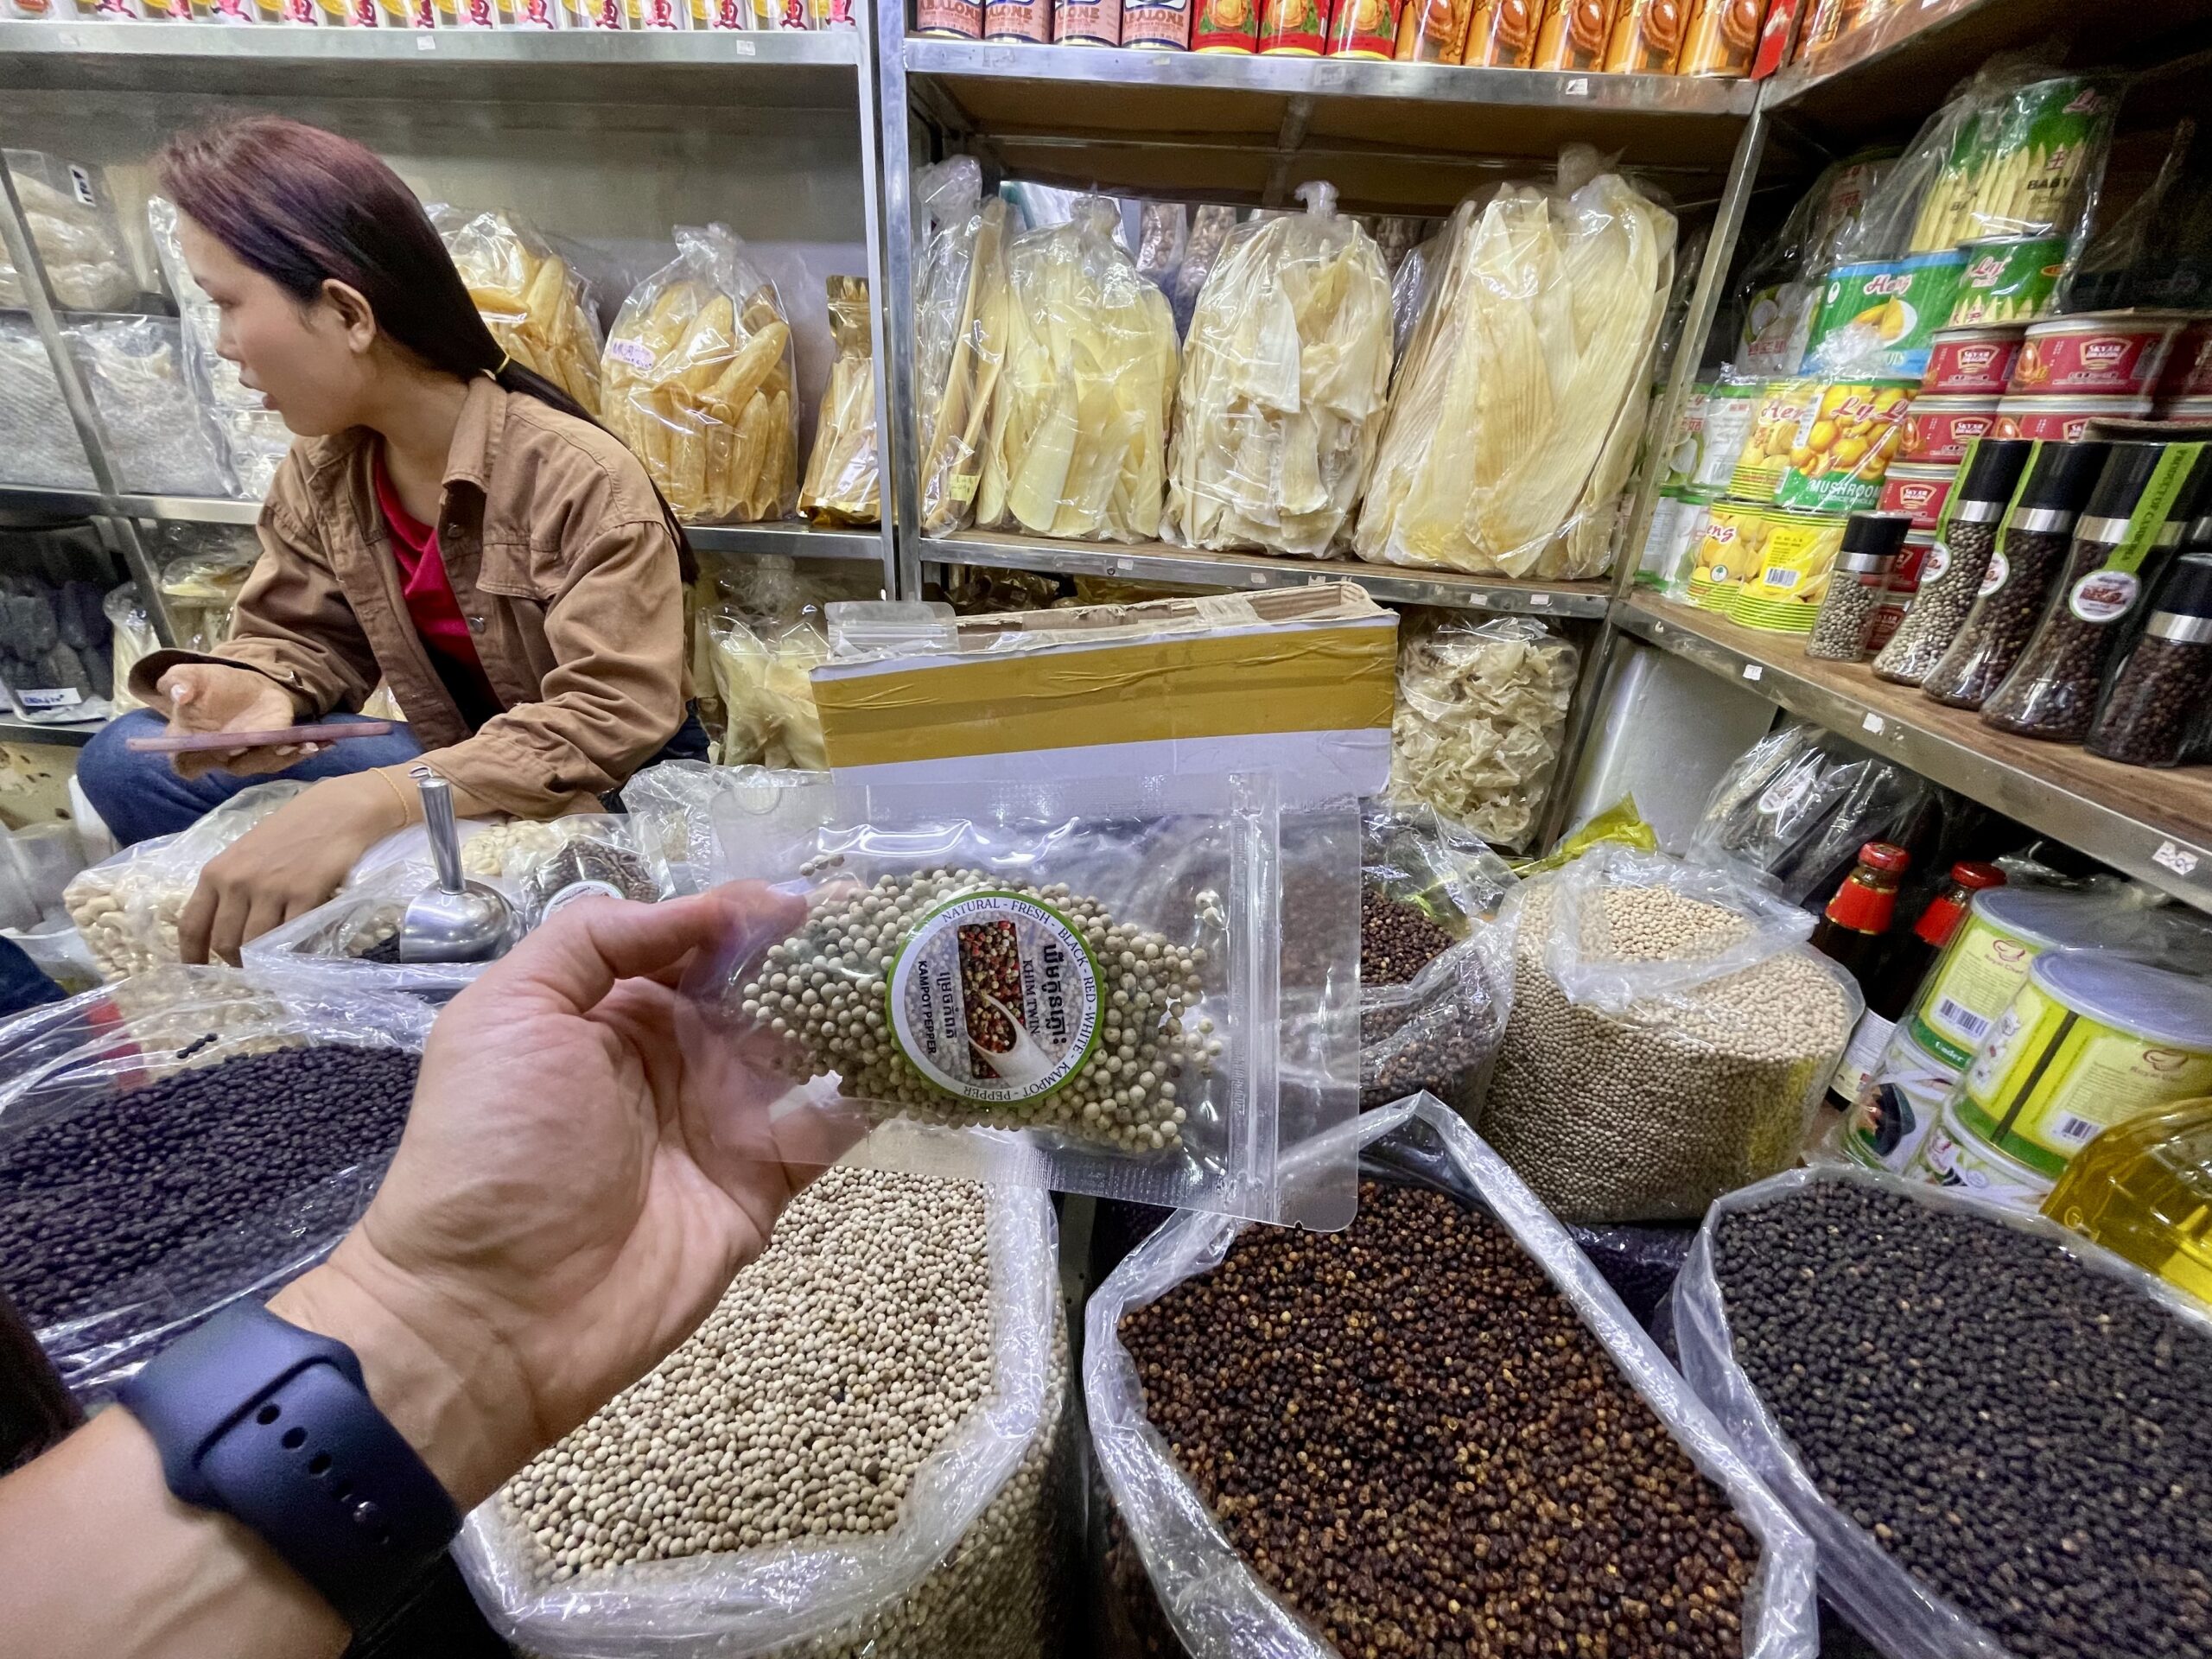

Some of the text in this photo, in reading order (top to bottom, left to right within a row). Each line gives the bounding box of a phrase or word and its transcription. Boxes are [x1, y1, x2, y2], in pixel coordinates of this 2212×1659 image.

[1707, 524, 1735, 543] eng
[942, 898, 1001, 923] NATURAL
[1011, 899, 1052, 925] FRESH
[1058, 927, 1089, 967] BLACK
[1022, 959, 1040, 1034] KHIM TWIN
[1084, 976, 1096, 1003] RED
[918, 960, 937, 1054] KAMPOT PEPPER
[1072, 1012, 1096, 1054] WHITE
[963, 1085, 1011, 1101] PEPPER
[1023, 1061, 1071, 1097] KAMPOT
